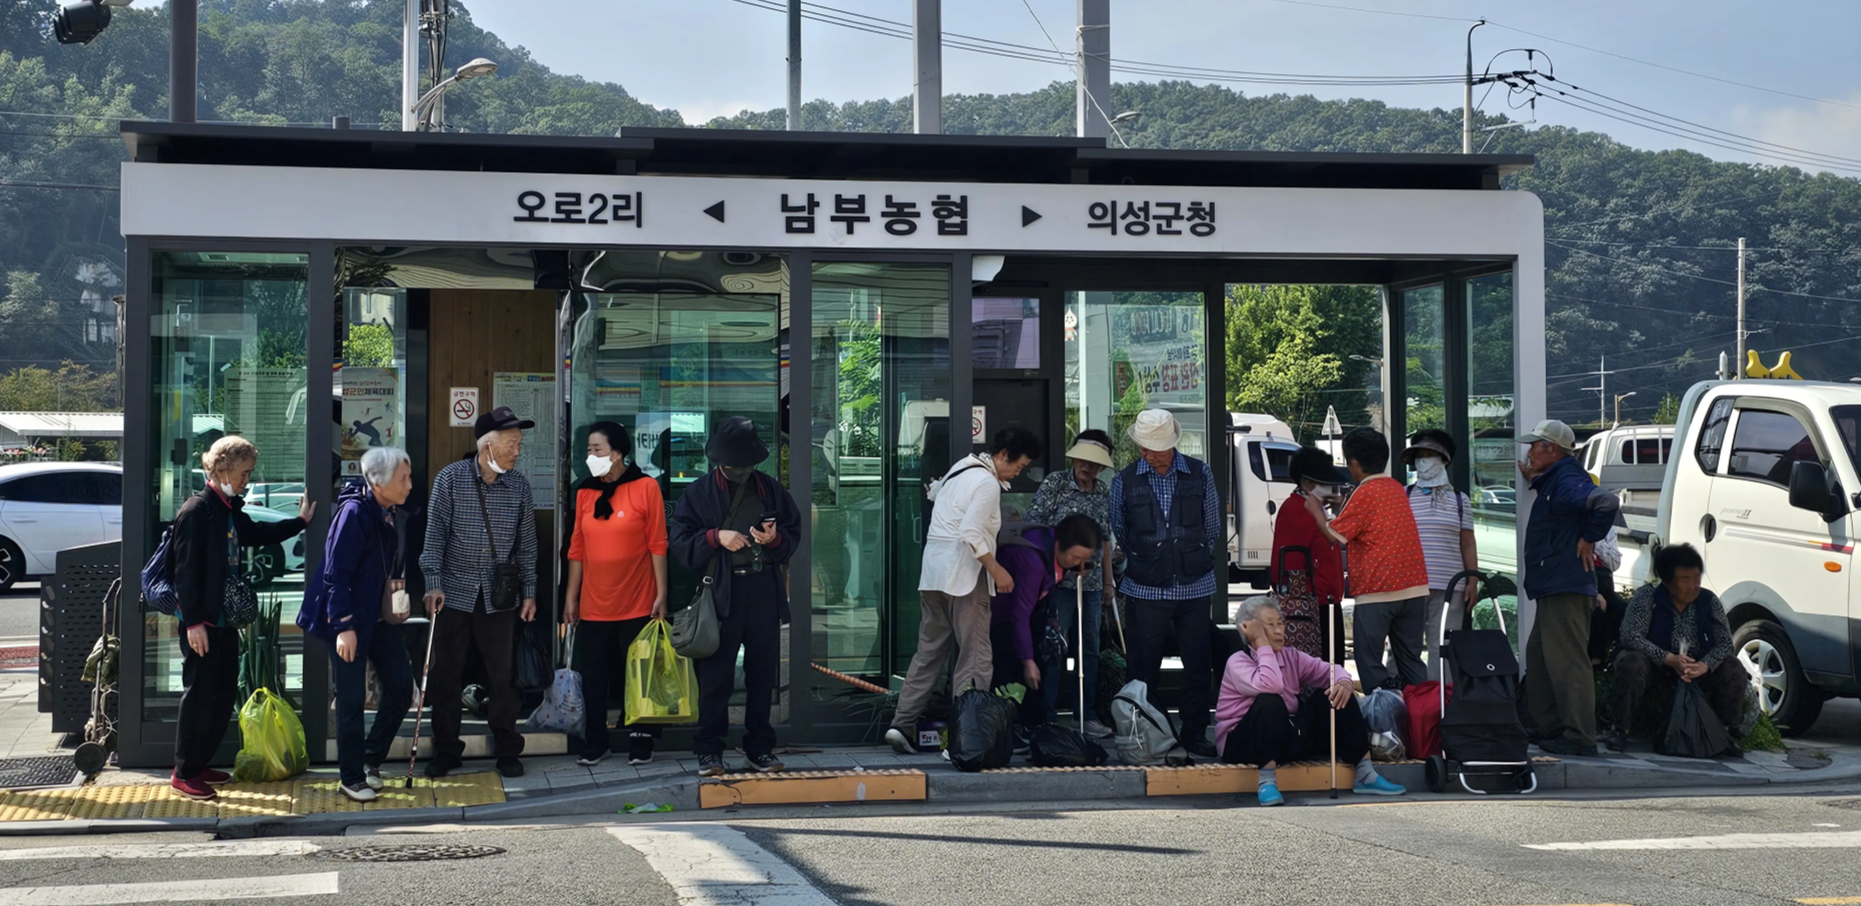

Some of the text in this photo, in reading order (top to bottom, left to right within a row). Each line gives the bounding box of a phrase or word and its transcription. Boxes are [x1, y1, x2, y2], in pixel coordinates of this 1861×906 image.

[513, 190, 1216, 237] 오로2리 남부농협 의성군청
